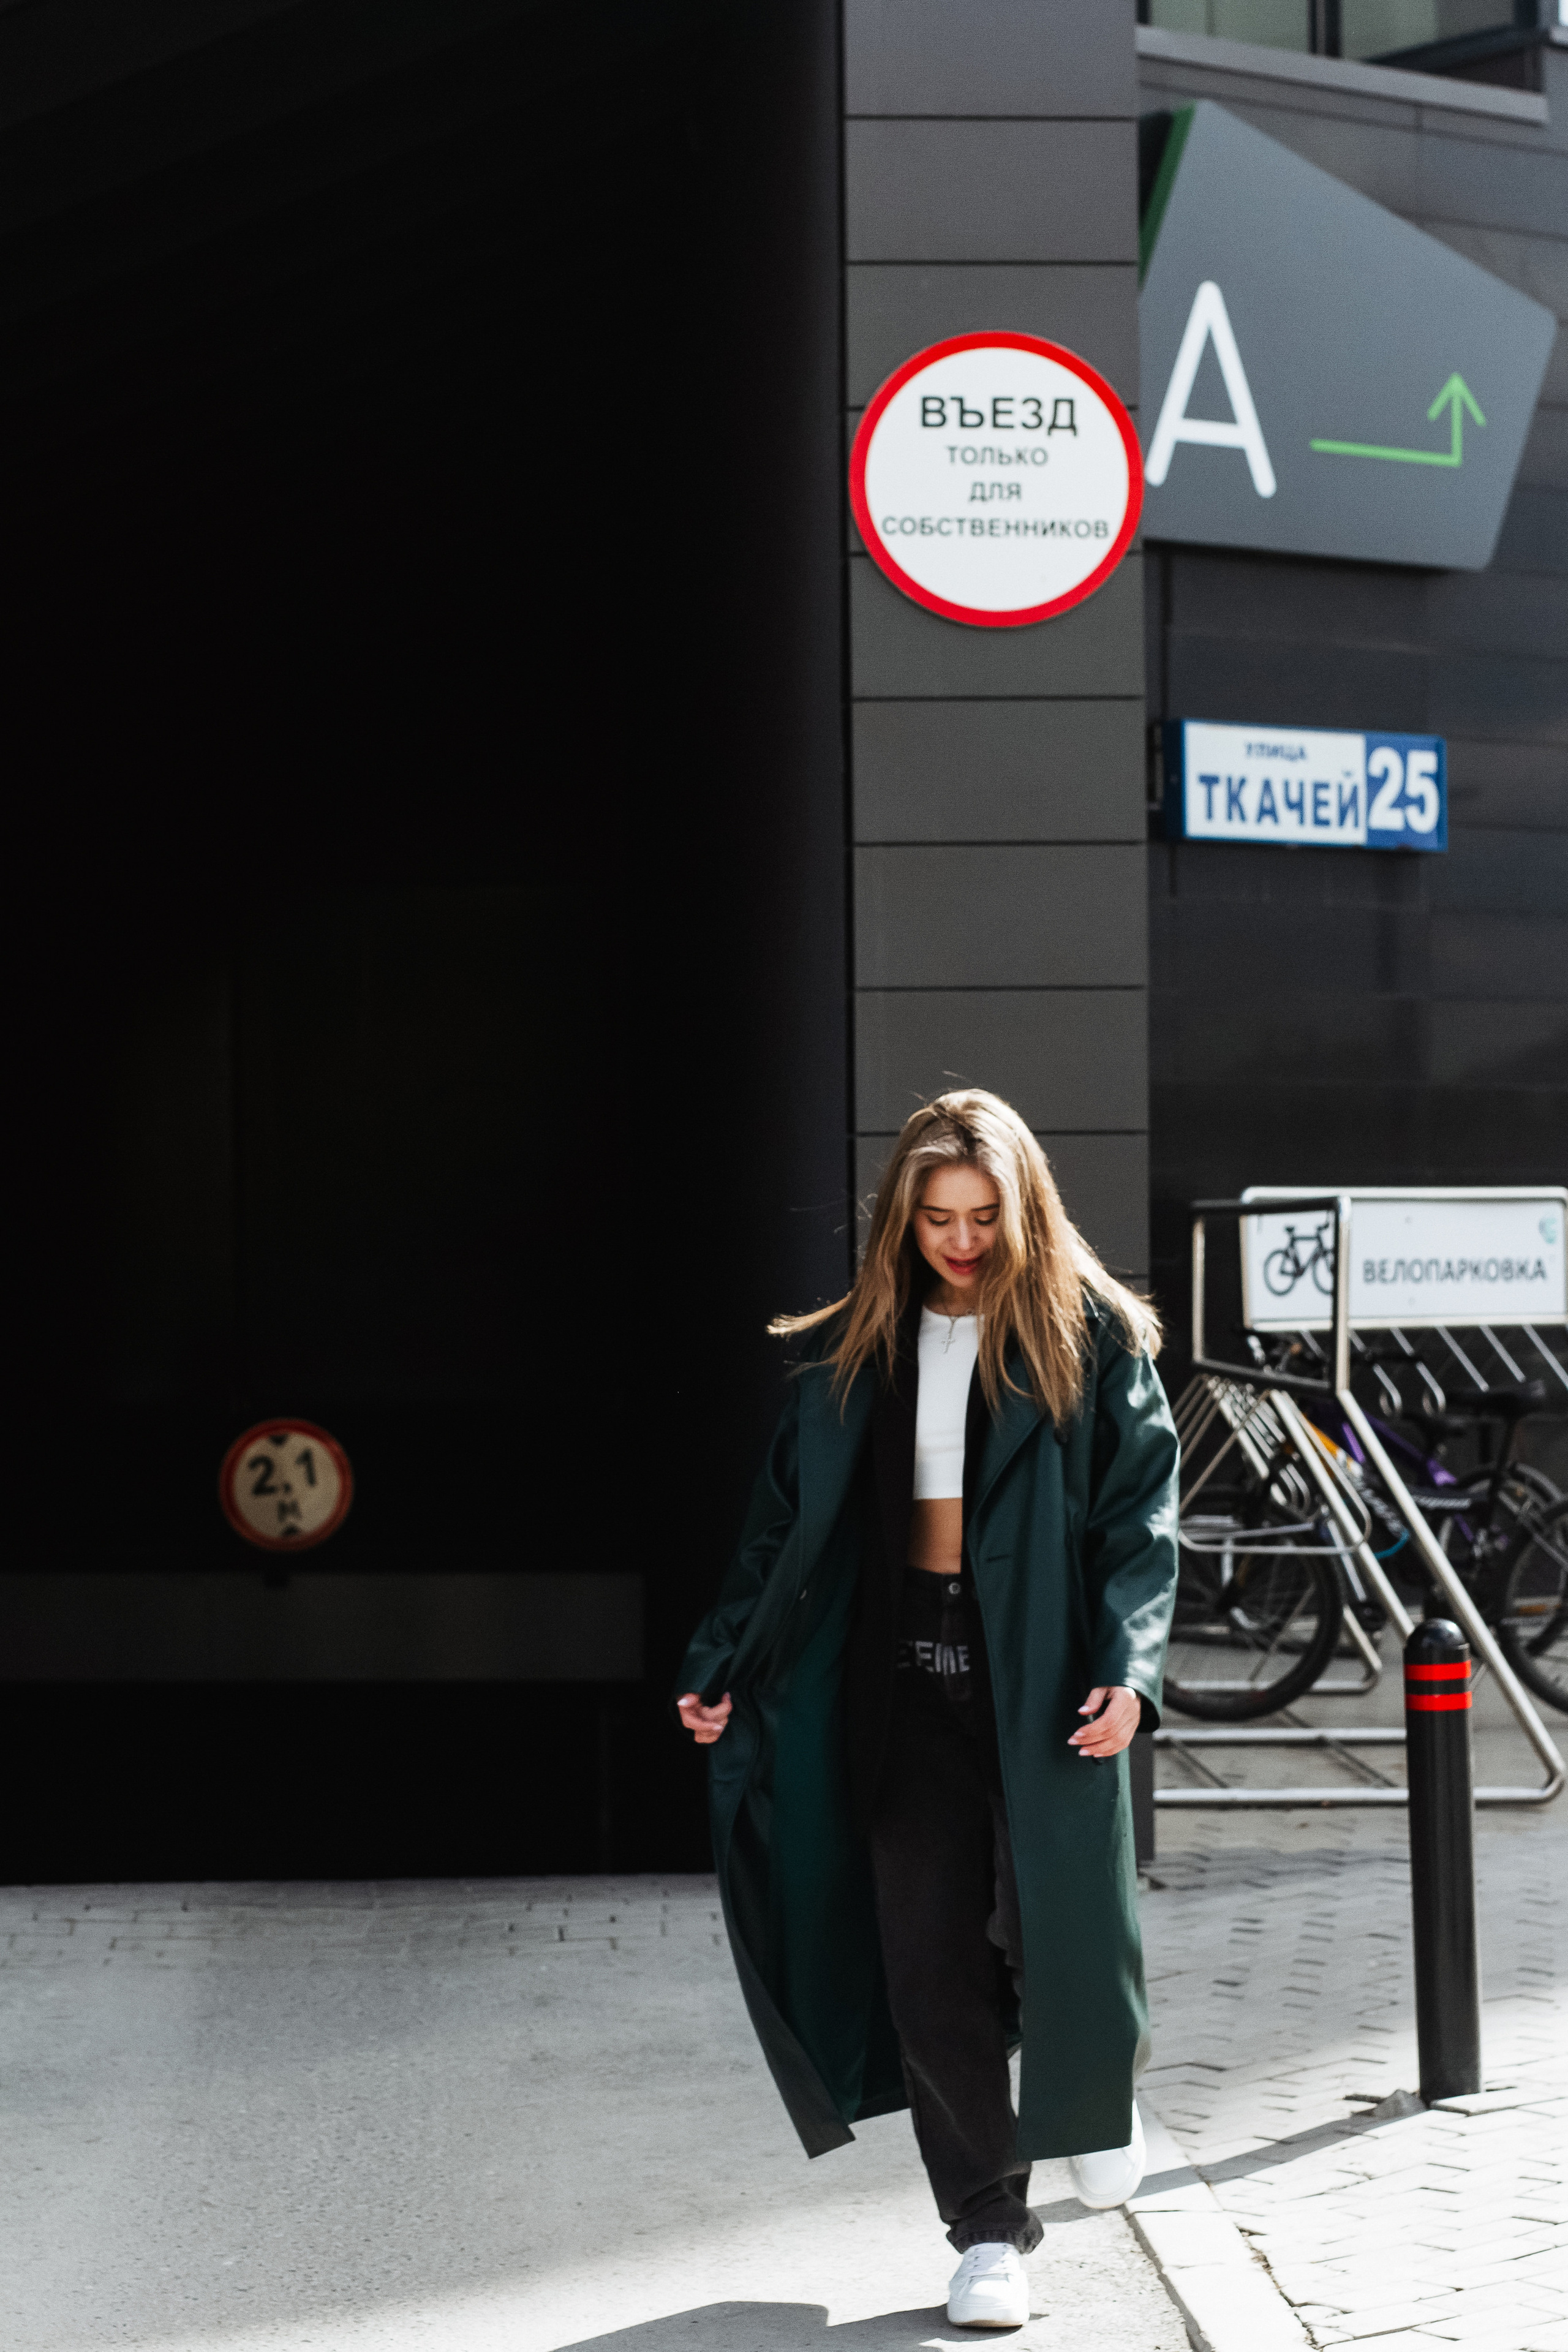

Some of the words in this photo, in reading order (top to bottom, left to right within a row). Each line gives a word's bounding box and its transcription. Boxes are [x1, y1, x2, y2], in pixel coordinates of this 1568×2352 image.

[921, 395, 1078, 437] ВЪЕЗД
[946, 445, 1049, 467] ТОЛЬКО
[969, 481, 1022, 502] ДЛЯ
[881, 516, 1110, 540] СОБСТВЕННИКОВ
[1244, 741, 1308, 763] УЛИЦА
[1197, 769, 1360, 829] ТКАЧЕЙ
[1368, 746, 1441, 834] 25
[1362, 1257, 1547, 1284] ВЕЛОПАРКОВКА
